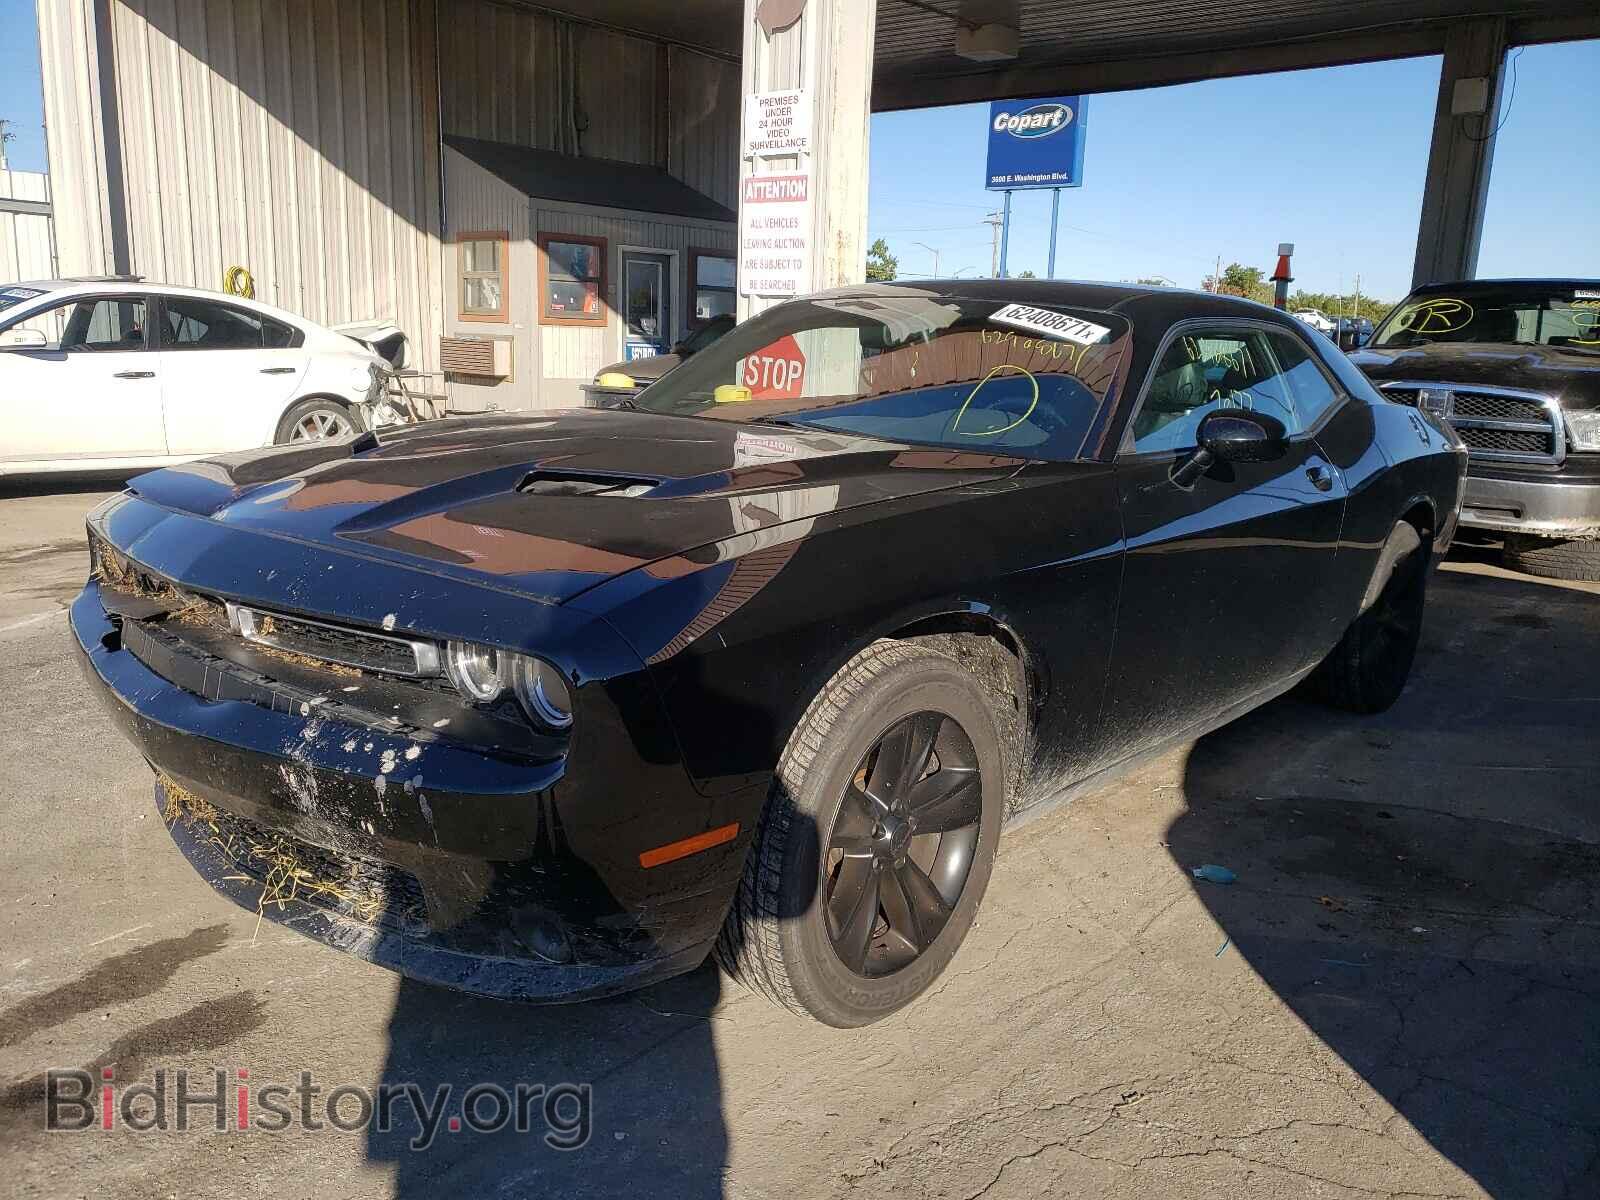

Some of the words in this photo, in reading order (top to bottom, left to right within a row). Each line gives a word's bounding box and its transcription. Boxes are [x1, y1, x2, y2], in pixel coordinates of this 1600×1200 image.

[759, 95, 799, 107] PREMISES
[765, 107, 792, 118] UNDER
[758, 120, 768, 129] 24
[771, 117, 793, 128] HOUR
[993, 107, 1063, 134] Copart
[766, 129, 790, 138] VIDEO
[749, 138, 807, 151] SURVEILLANCE
[1014, 173, 1051, 182] Washington
[745, 180, 806, 200] ATTENTION
[750, 218, 763, 229] ALL
[764, 217, 799, 229] VEHICLES
[743, 239, 772, 249] LEAVING
[774, 239, 806, 249] AUCTION
[744, 260, 757, 270] ARE
[759, 259, 790, 270] SUBJECT
[793, 259, 802, 269] TO
[749, 280, 758, 290] BE
[760, 279, 796, 290] SEARCHED
[745, 355, 802, 392] STOP
